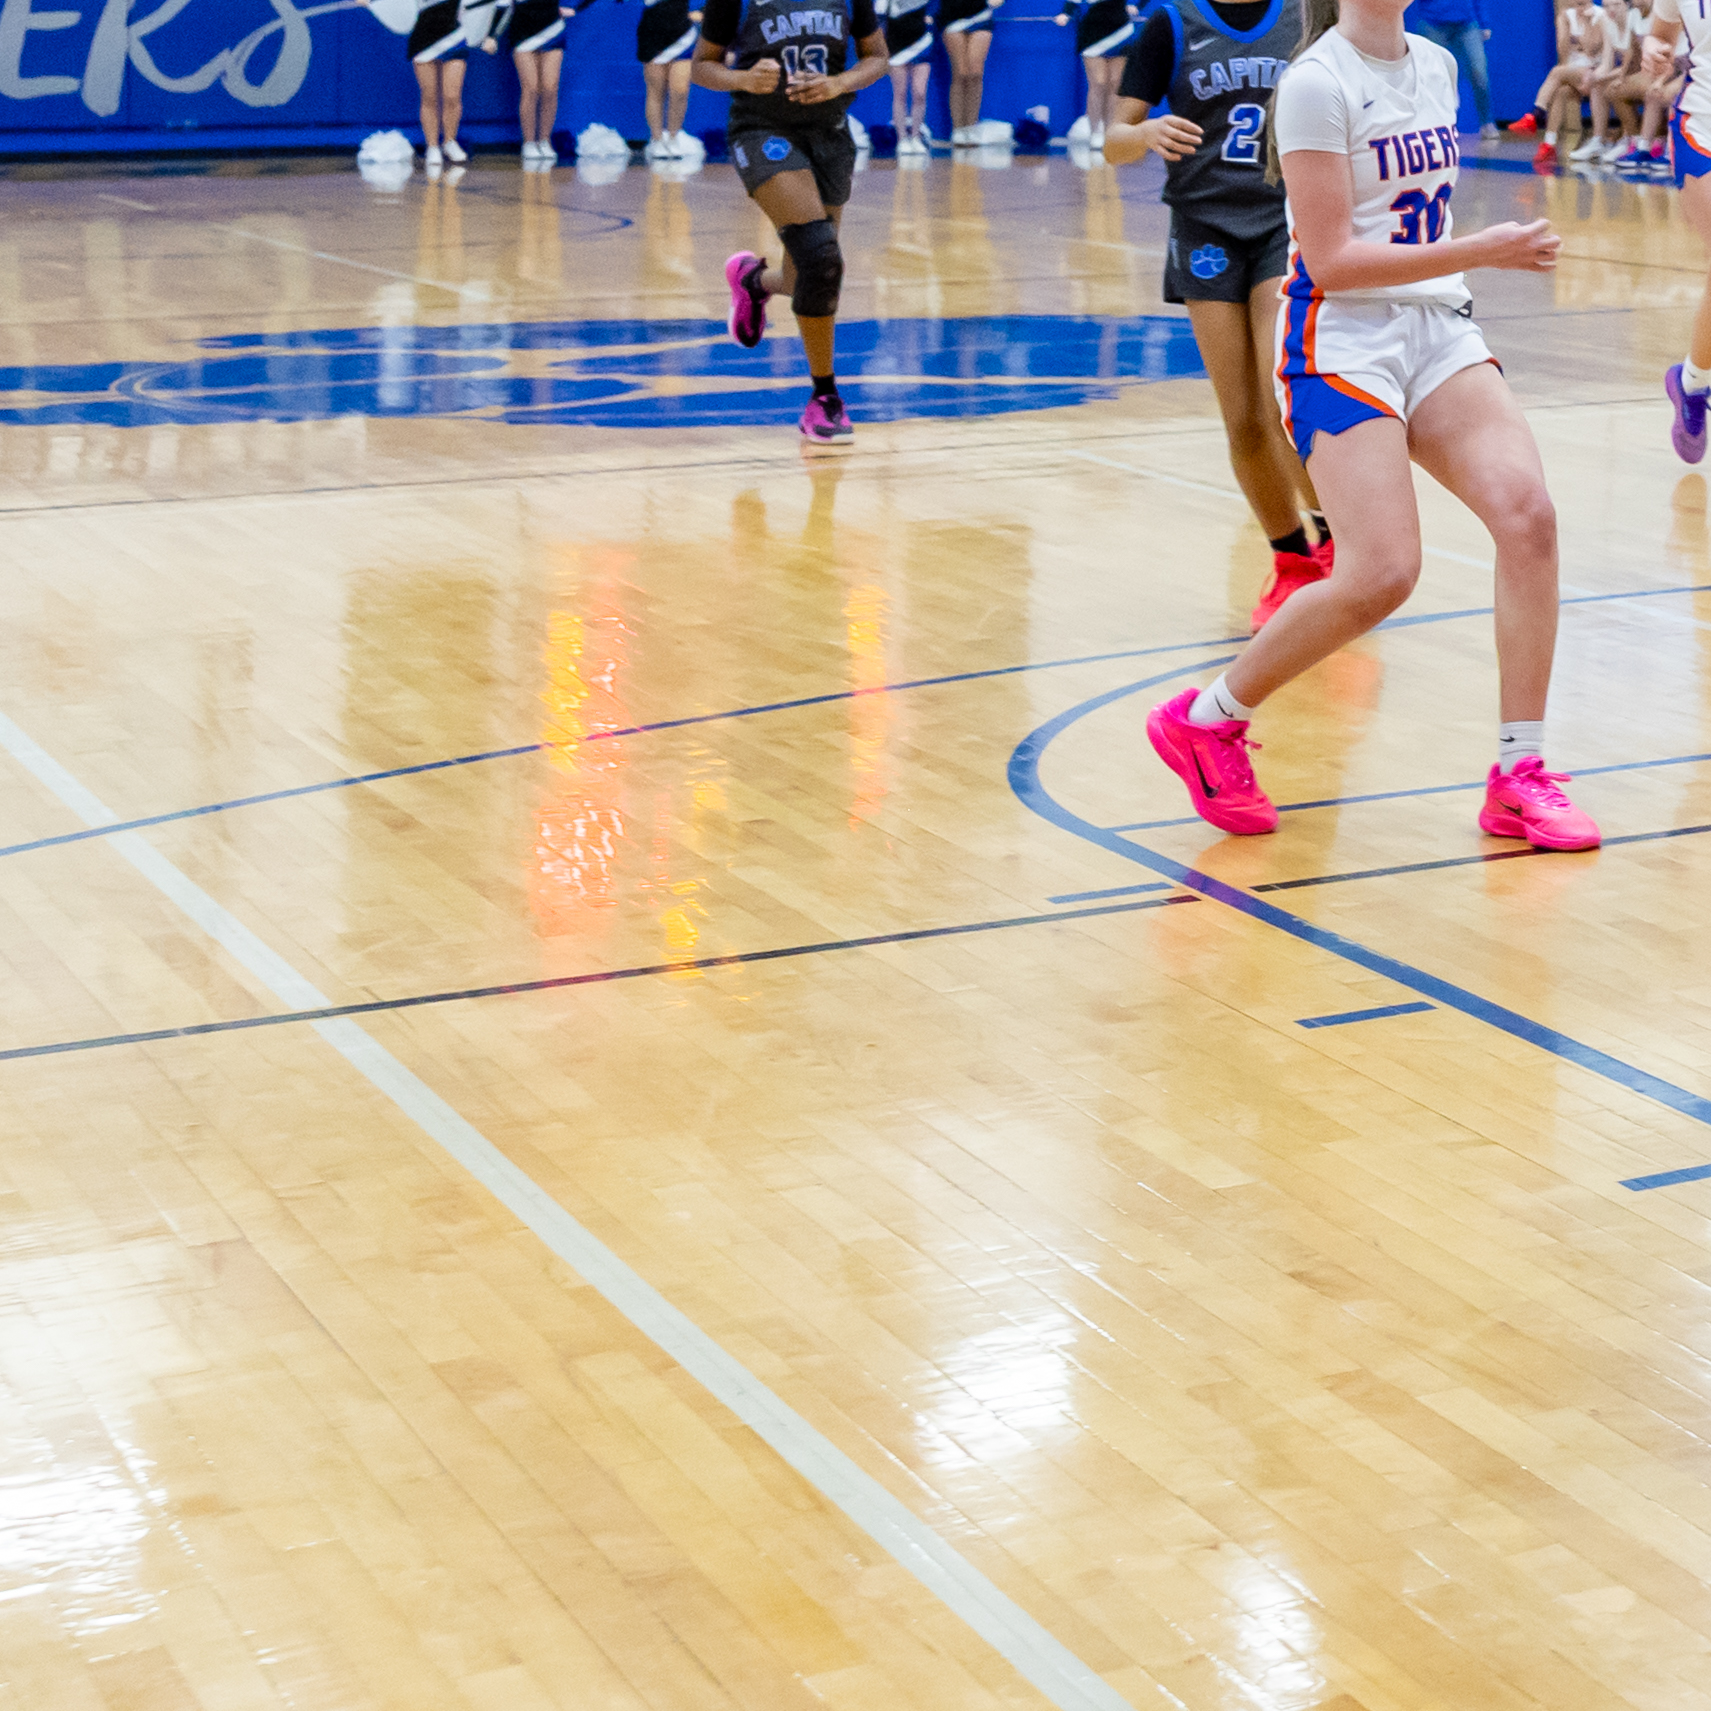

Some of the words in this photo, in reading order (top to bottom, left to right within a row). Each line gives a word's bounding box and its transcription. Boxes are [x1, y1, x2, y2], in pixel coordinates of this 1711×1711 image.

[760, 9, 843, 45] CAPITAL
[781, 44, 829, 84] 13
[1189, 56, 1290, 101] CAPITA
[1221, 103, 1267, 164] 2
[1389, 181, 1453, 245] 30
